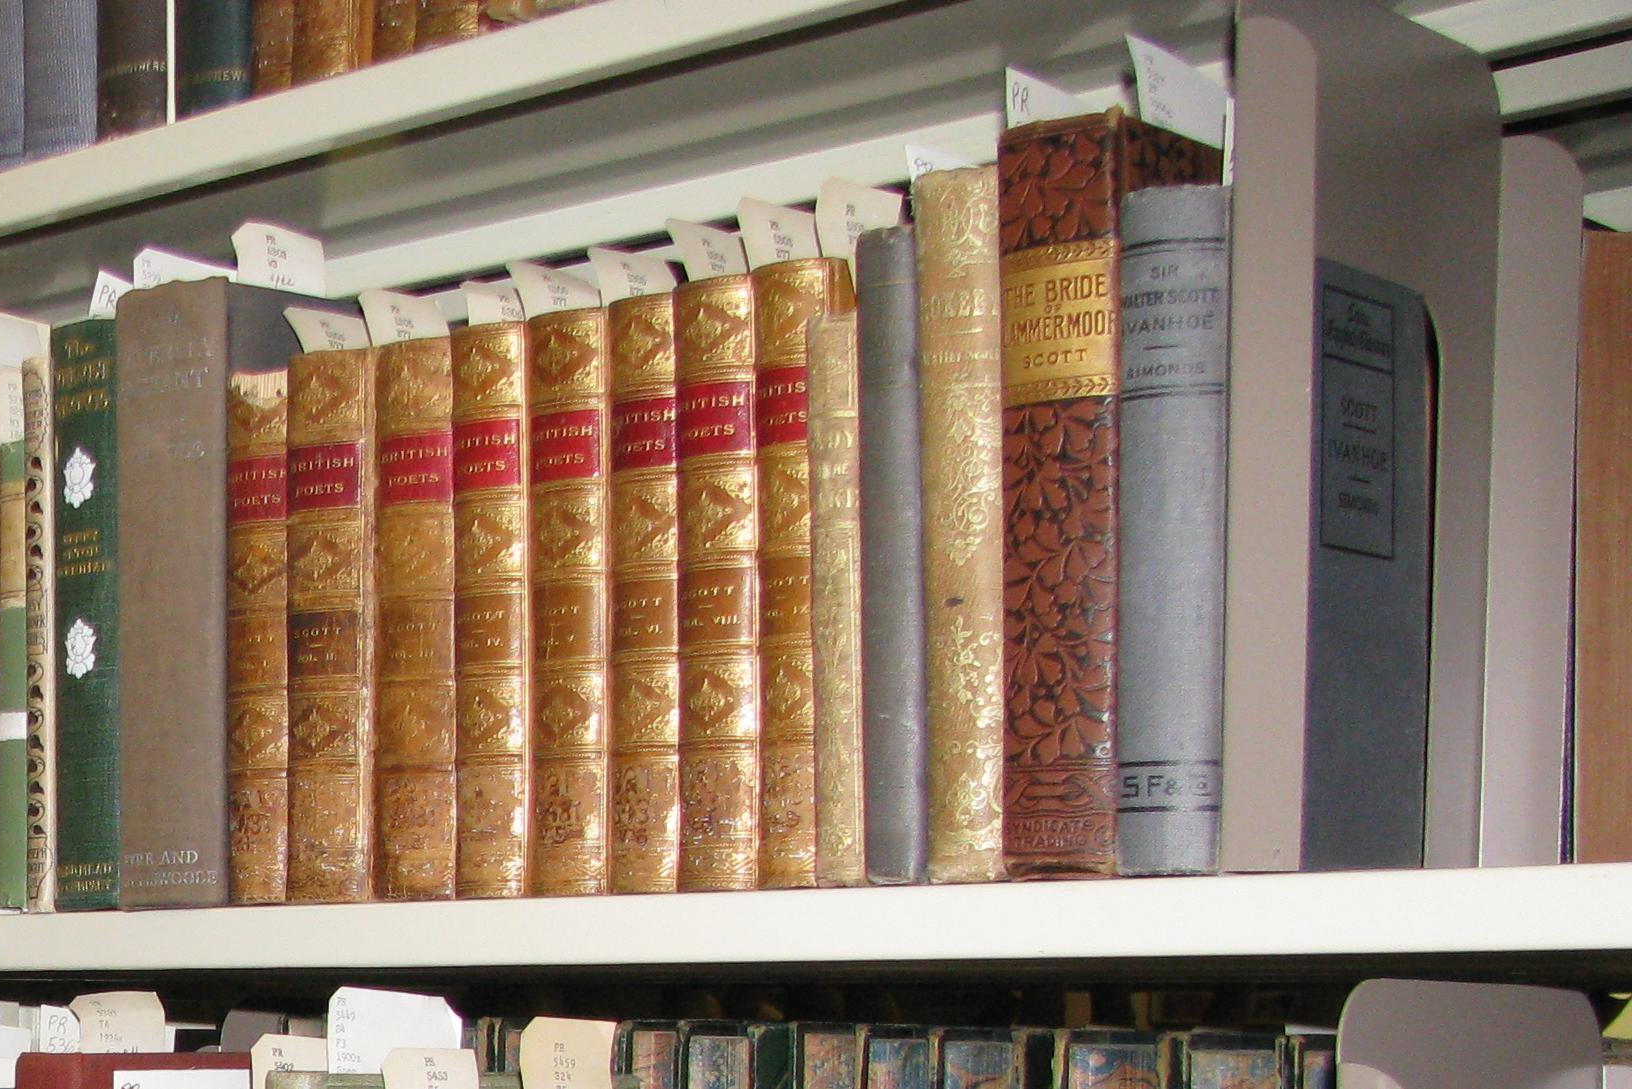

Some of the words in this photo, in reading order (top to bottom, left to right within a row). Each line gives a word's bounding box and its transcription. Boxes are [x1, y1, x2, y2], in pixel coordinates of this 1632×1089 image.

[1012, 83, 1030, 115] PR
[1150, 265, 1179, 280] SIR
[99, 285, 117, 309] PR
[1003, 283, 1036, 312] THE
[1045, 273, 1109, 303] BRIDE
[1044, 303, 1062, 315] OF
[1022, 348, 1088, 369] SCOTT
[759, 381, 807, 399] RITIS
[680, 393, 745, 413] RITISH
[617, 406, 676, 427] RITISH
[767, 409, 807, 426] OETS
[687, 423, 736, 440] OETS
[458, 432, 516, 450] RITISH
[622, 438, 666, 453] OETS
[380, 446, 449, 465] BRITISH
[290, 456, 355, 474] BRITISH
[463, 460, 507, 474] OETS
[387, 473, 441, 487] POETS
[295, 482, 345, 498] POETS
[233, 493, 281, 508] POETS
[767, 575, 809, 589] COTT
[458, 609, 505, 624] OTT
[161, 850, 199, 866] AND
[48, 1014, 68, 1035] PR
